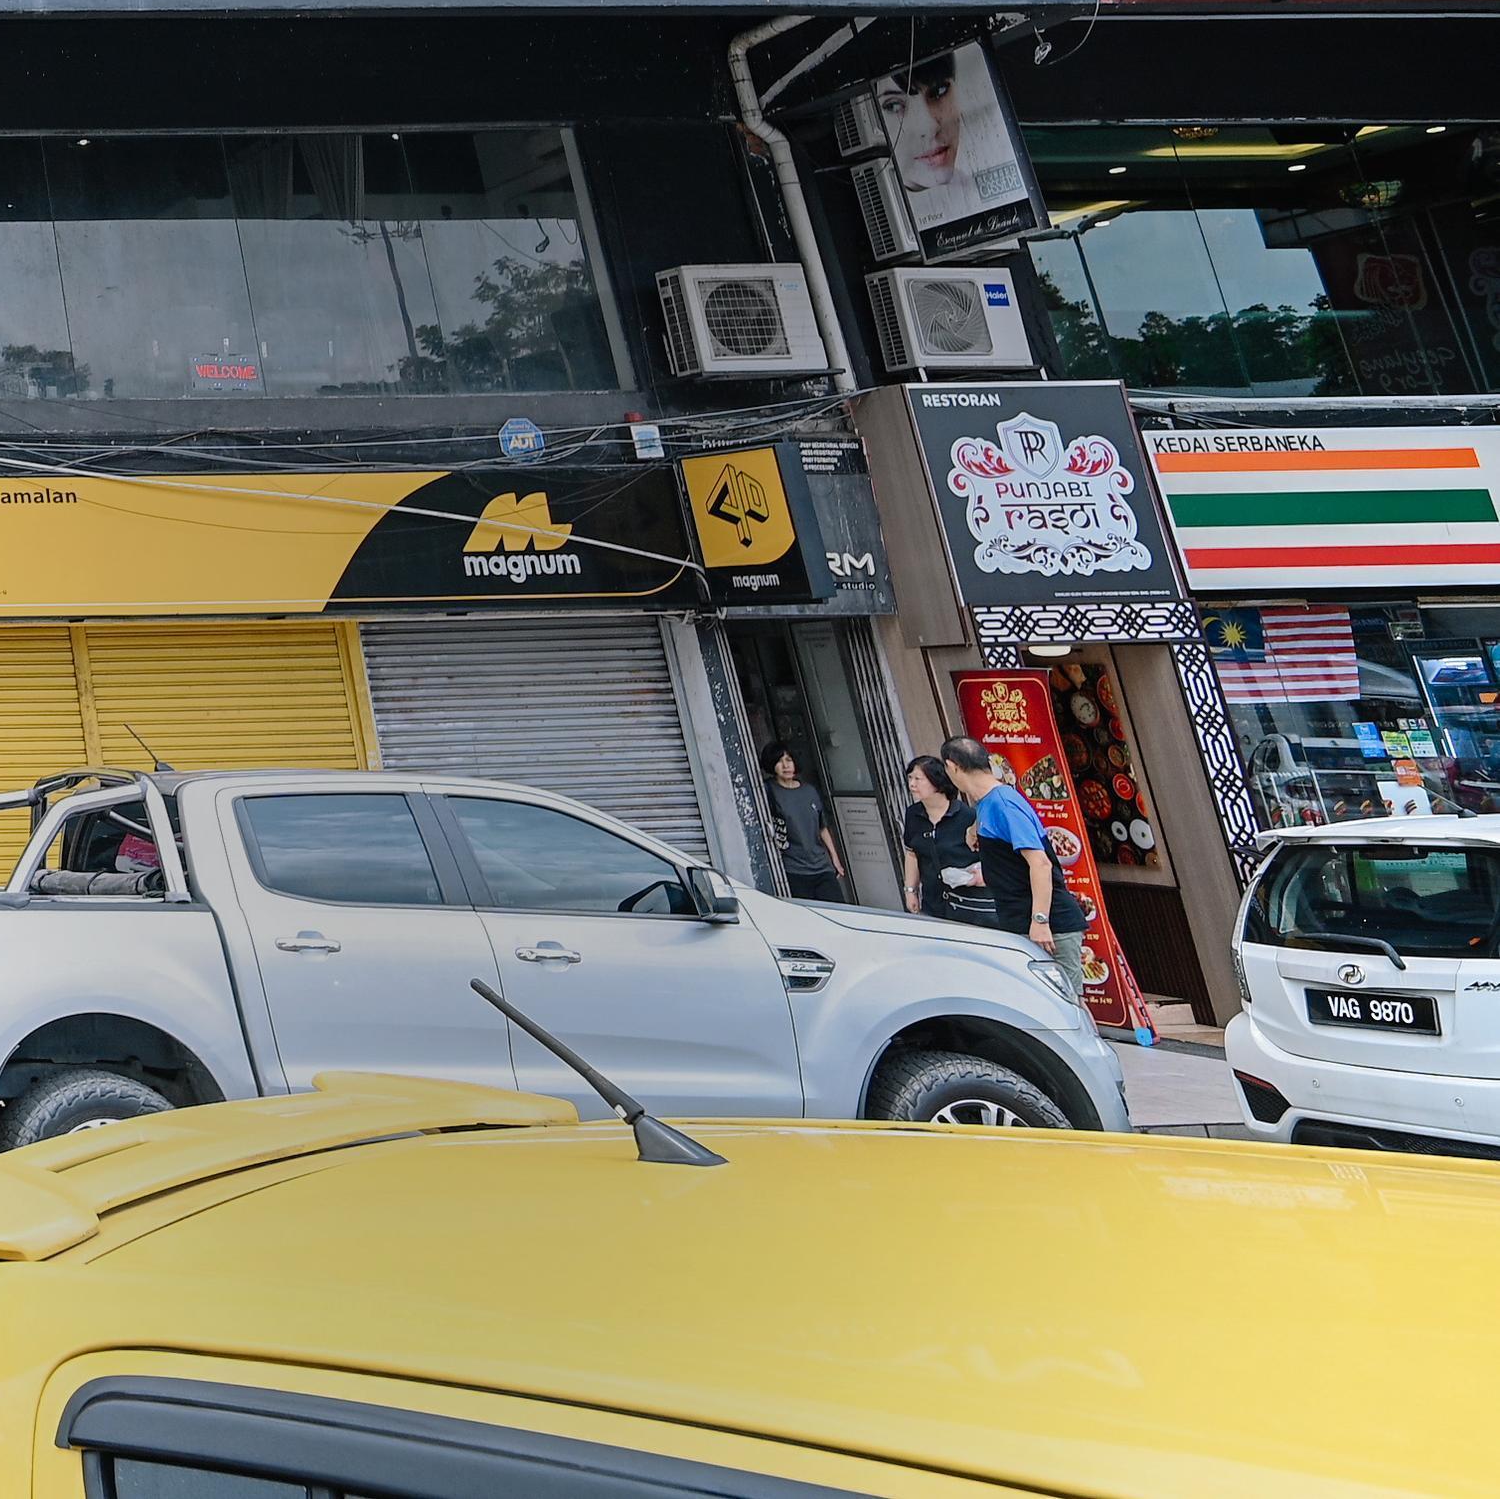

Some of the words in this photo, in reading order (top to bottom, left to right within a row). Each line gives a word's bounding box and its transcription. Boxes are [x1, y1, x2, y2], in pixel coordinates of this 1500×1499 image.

[195, 364, 258, 379] WELCOME
[921, 392, 1001, 408] RESTORAN
[509, 434, 536, 450] ADT
[1153, 436, 1208, 453] KEDAI
[1214, 434, 1325, 453] SERBANEKA
[996, 481, 1093, 500] PUNJABI
[463, 551, 582, 583] magnum
[732, 573, 781, 591] magnum
[841, 582, 876, 590] studio
[1326, 995, 1361, 1021] VAG
[1369, 999, 1413, 1024] 9870
